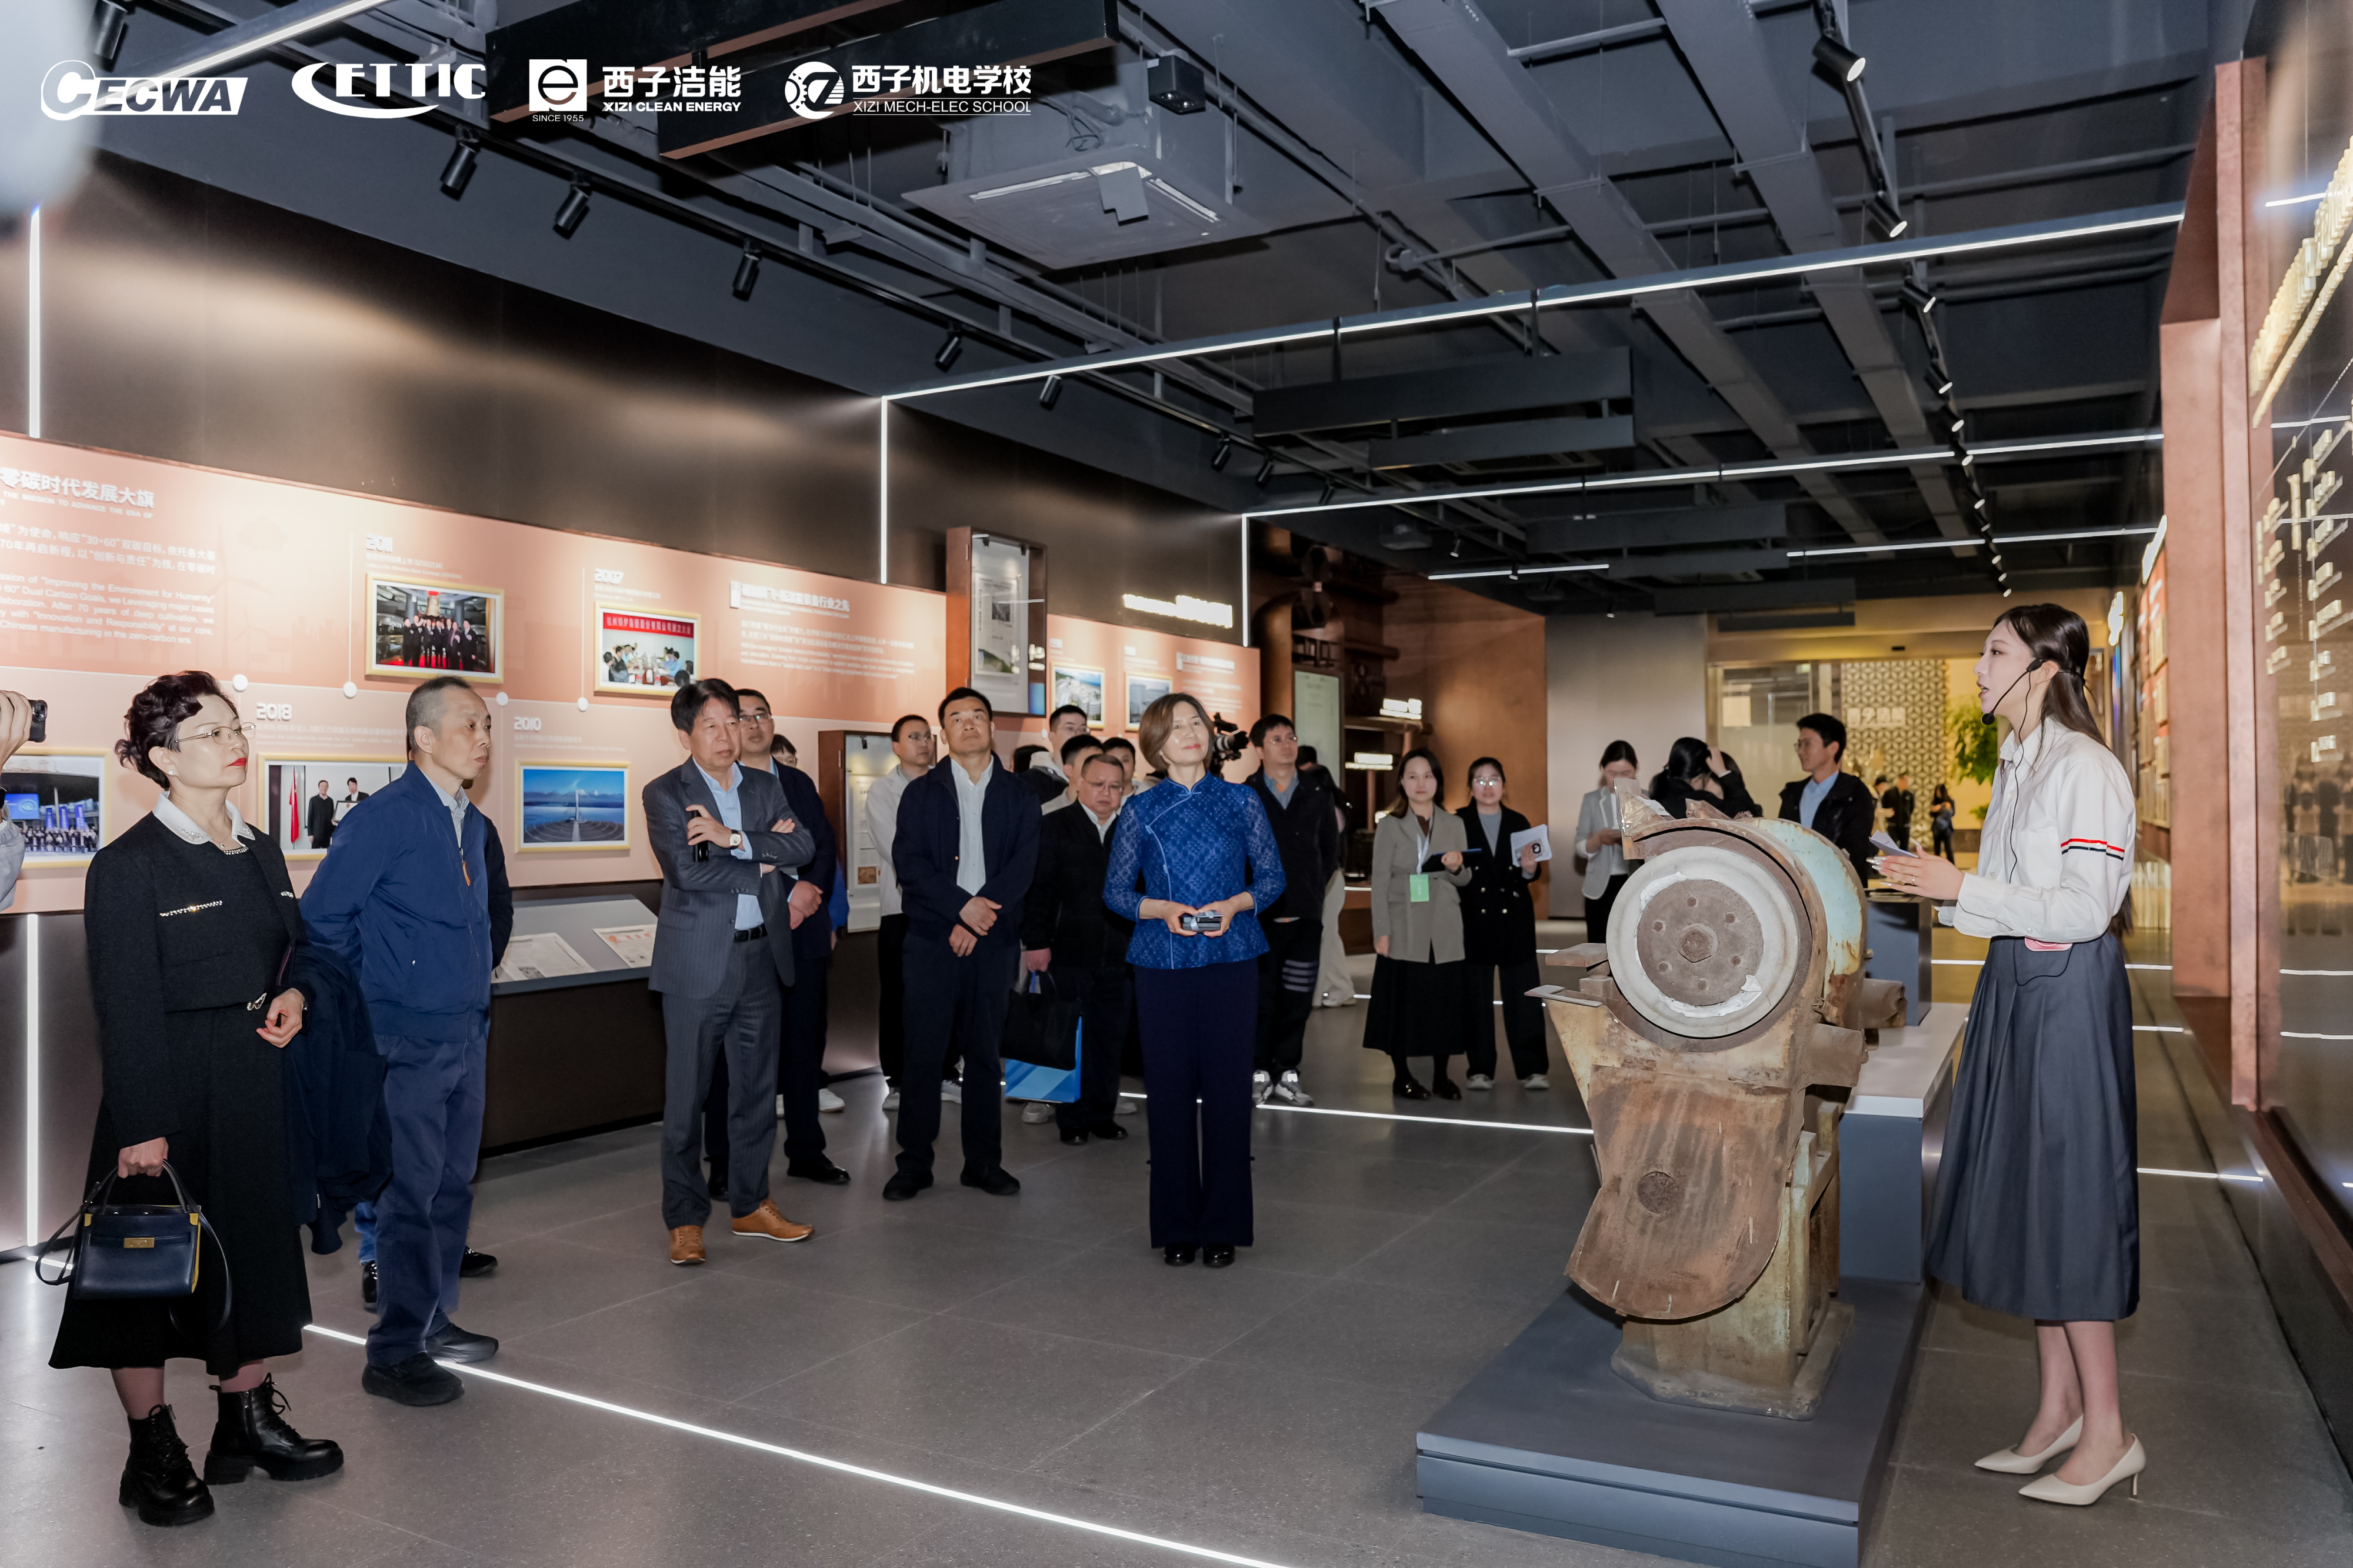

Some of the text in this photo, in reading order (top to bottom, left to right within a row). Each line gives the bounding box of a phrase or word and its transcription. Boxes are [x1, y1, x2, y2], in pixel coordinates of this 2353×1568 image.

[0, 467, 154, 508] 零碳时代发展大旗
[366, 533, 393, 552] 2011
[22, 586, 44, 596] Dual
[45, 589, 78, 599] Carbon
[122, 597, 167, 610] Leveraging
[91, 582, 105, 590] the
[162, 589, 174, 598] for
[78, 603, 89, 612] 70
[0, 619, 38, 631] Chinese
[40, 625, 102, 638] manufacturing
[256, 703, 292, 721] 2018
[514, 716, 542, 732] 2010
